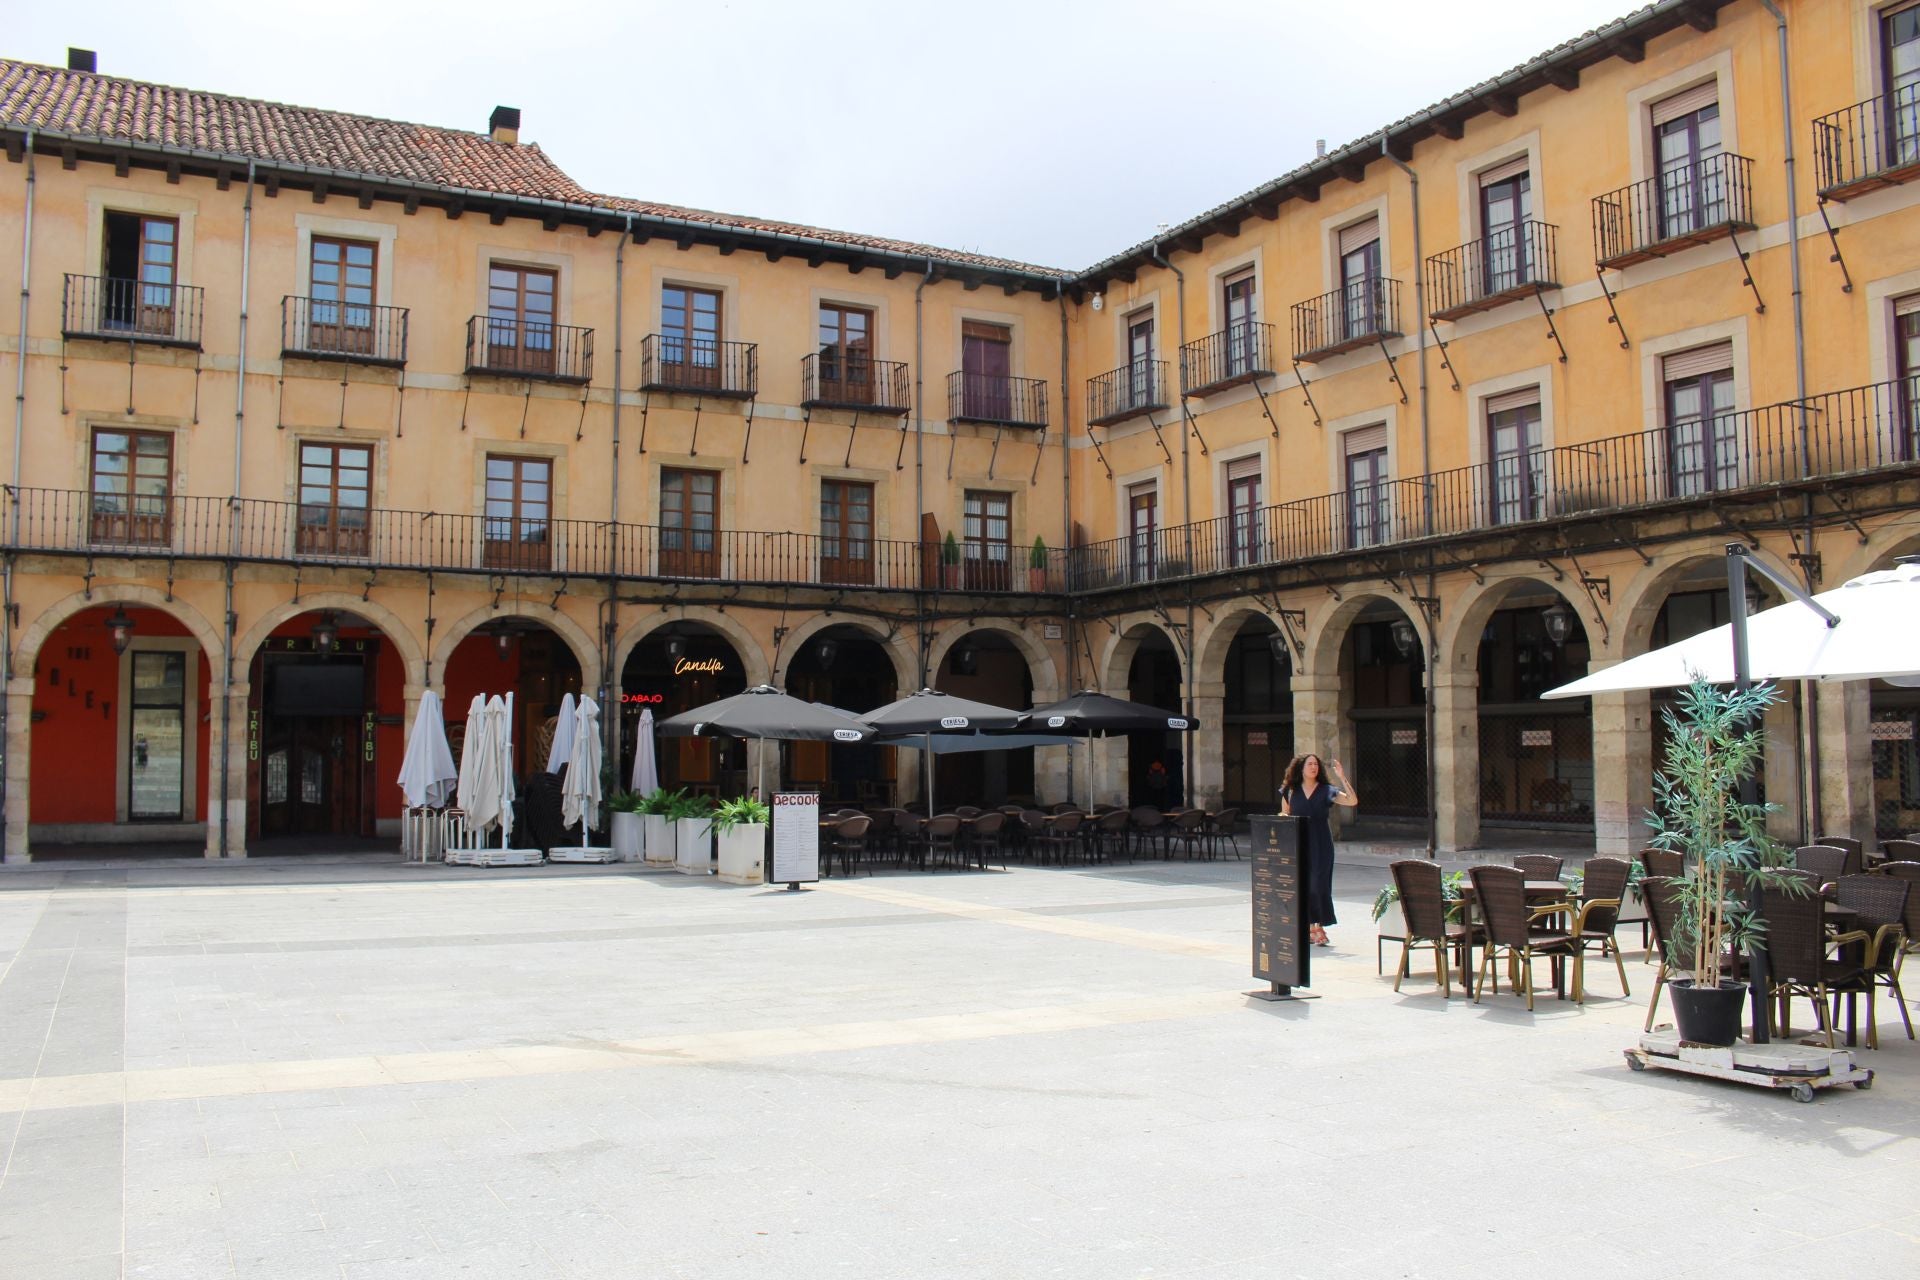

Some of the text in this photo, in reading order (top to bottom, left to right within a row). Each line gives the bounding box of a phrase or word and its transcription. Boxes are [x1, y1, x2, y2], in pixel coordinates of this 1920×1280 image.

[263, 640, 364, 650] TRIBU
[675, 657, 724, 675] Canalla
[631, 694, 663, 703] ABAJO
[250, 711, 258, 760] TRIBU
[365, 713, 373, 761] TRIBU
